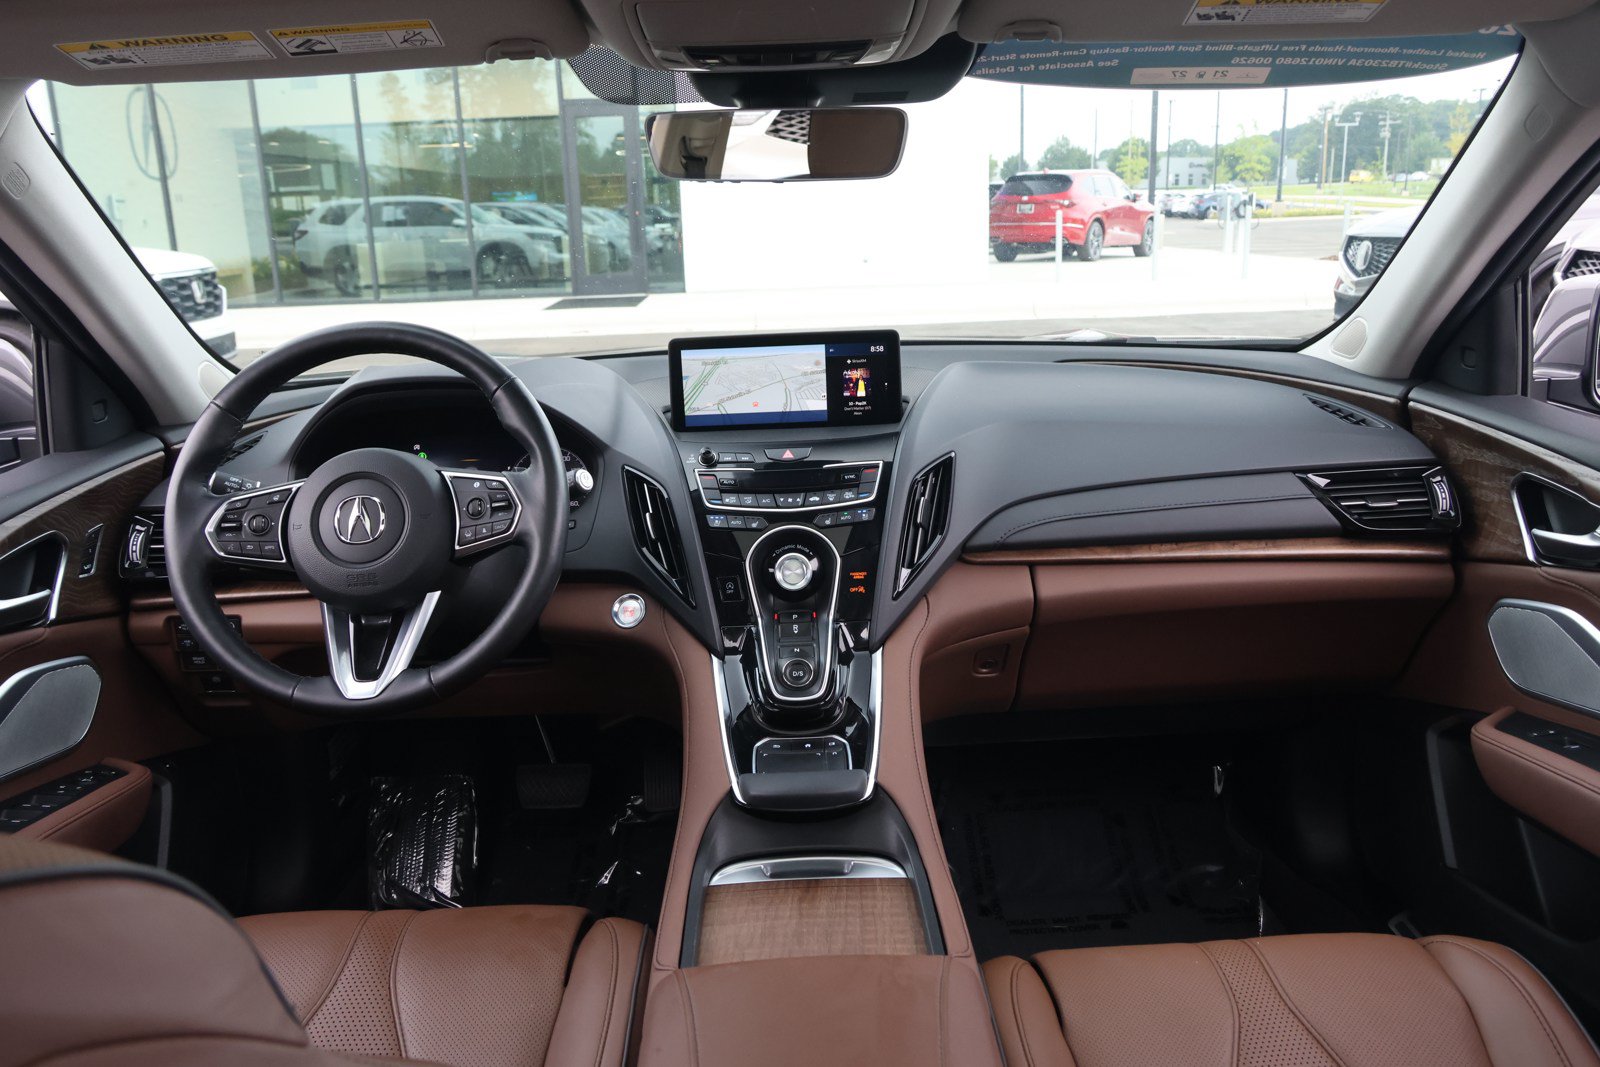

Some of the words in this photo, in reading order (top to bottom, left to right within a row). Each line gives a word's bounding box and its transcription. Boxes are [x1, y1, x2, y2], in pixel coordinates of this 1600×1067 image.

[292, 26, 350, 36] WARNING
[117, 33, 229, 49] WARNING
[775, 544, 796, 554] Dynamic
[797, 544, 810, 553] Mode
